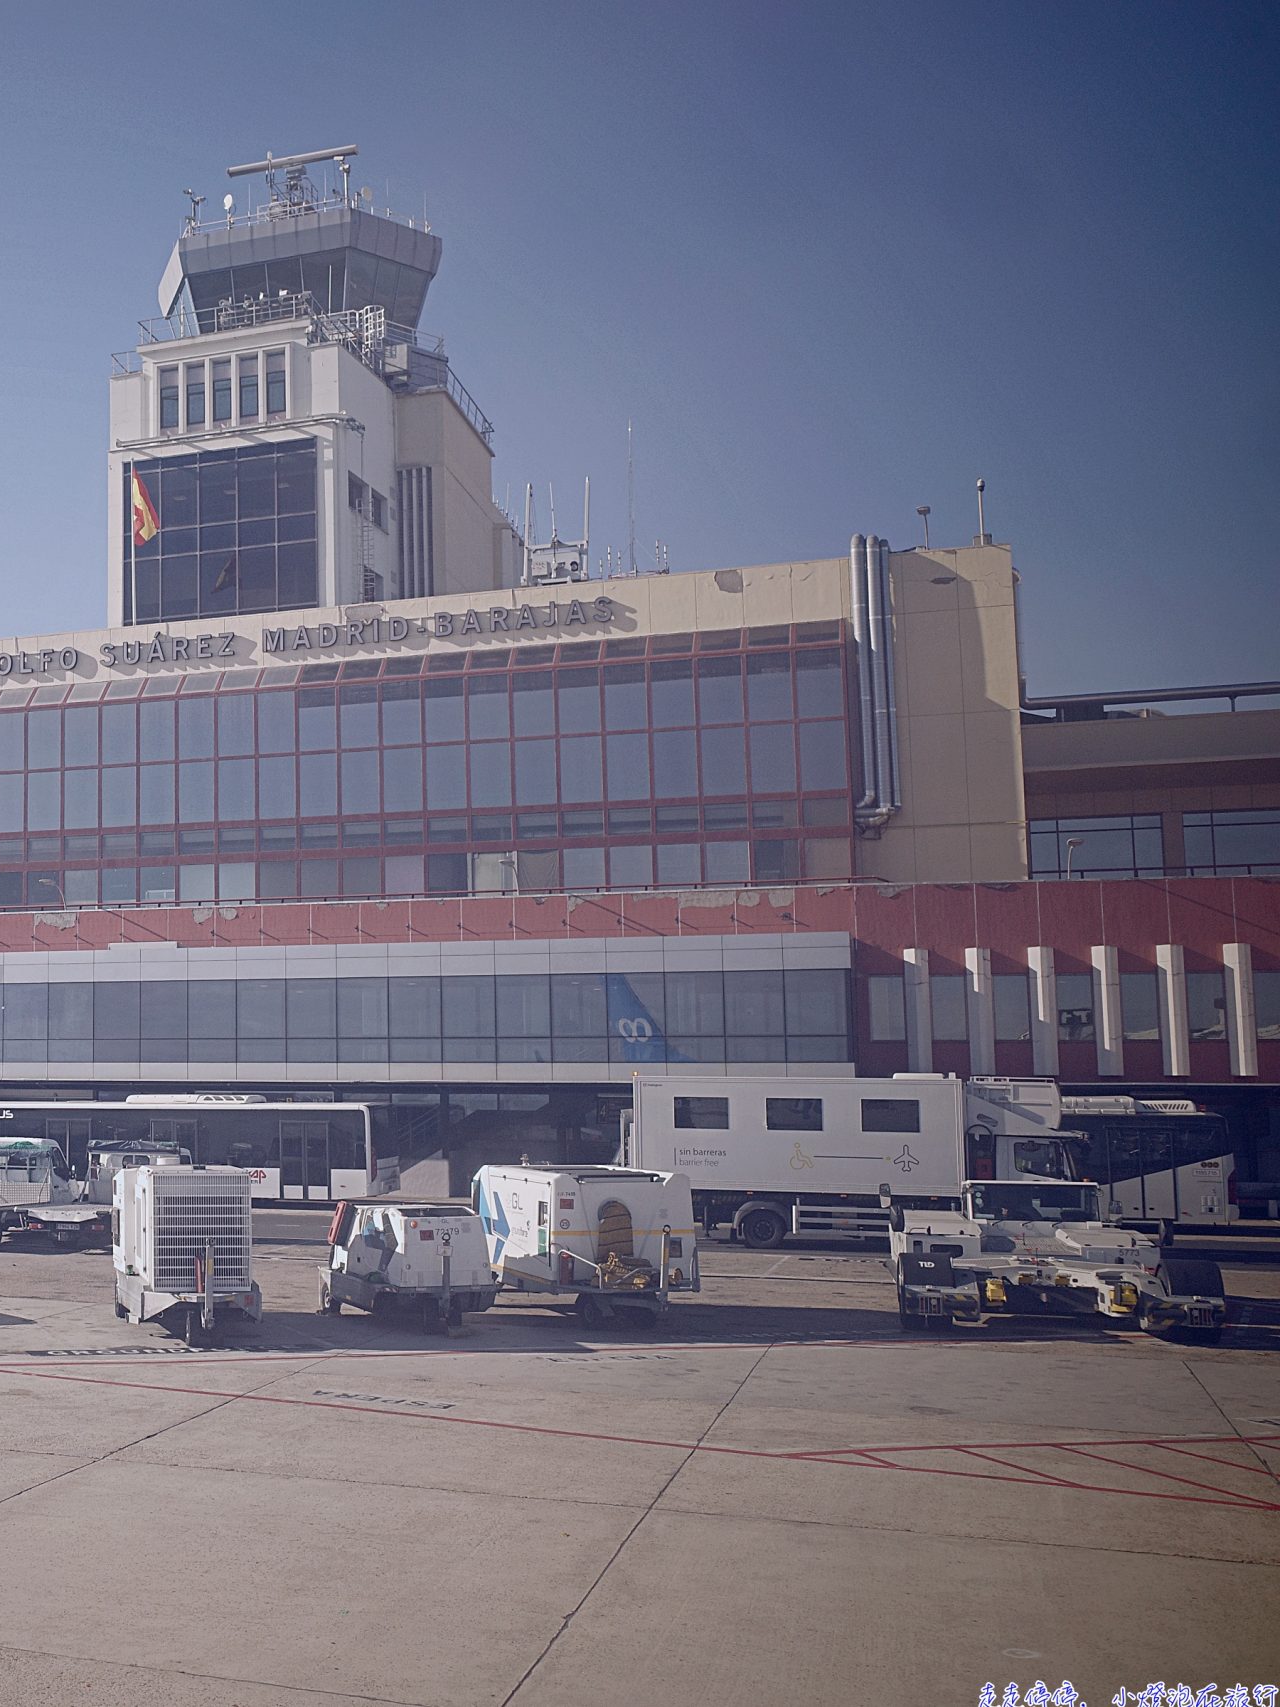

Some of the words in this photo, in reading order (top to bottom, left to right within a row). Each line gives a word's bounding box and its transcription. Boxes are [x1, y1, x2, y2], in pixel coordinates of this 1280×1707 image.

[100, 631, 235, 667] SUÁREZ
[262, 596, 614, 653] MADRID-BARAJAS
[600, 1104, 607, 1116] 4
[679, 1147, 691, 1156] sin
[692, 1147, 727, 1157] barreras
[679, 1158, 703, 1166] barrier
[704, 1158, 720, 1167] free
[512, 1192, 523, 1210] GL
[435, 1227, 460, 1236] 72179
[1119, 1249, 1140, 1257] 5773
[918, 1261, 935, 1269] TLD
[312, 1389, 457, 1410] ESPERA
